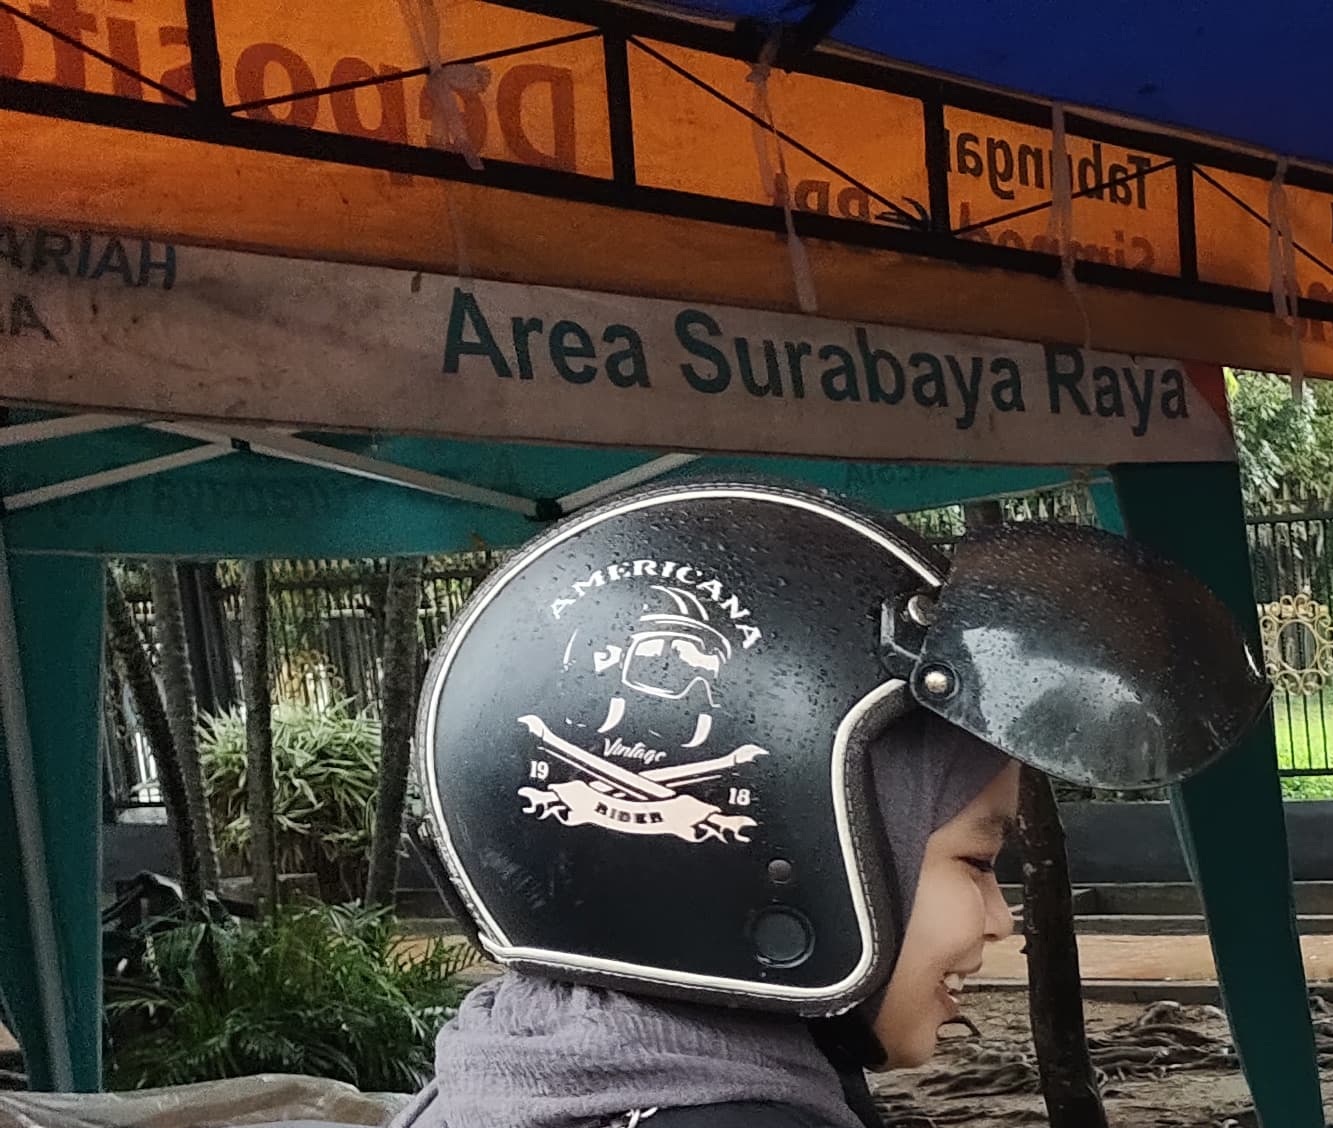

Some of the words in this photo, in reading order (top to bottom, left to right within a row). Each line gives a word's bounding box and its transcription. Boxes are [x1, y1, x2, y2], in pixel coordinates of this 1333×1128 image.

[442, 286, 652, 390] Area
[674, 308, 1026, 431] Surabaya
[1042, 343, 1190, 438] Raya
[550, 559, 763, 650] AMERICANA
[603, 737, 667, 765] Vintage
[529, 760, 550, 780] 19
[728, 787, 751, 806] 18
[594, 802, 664, 824] RIDER
